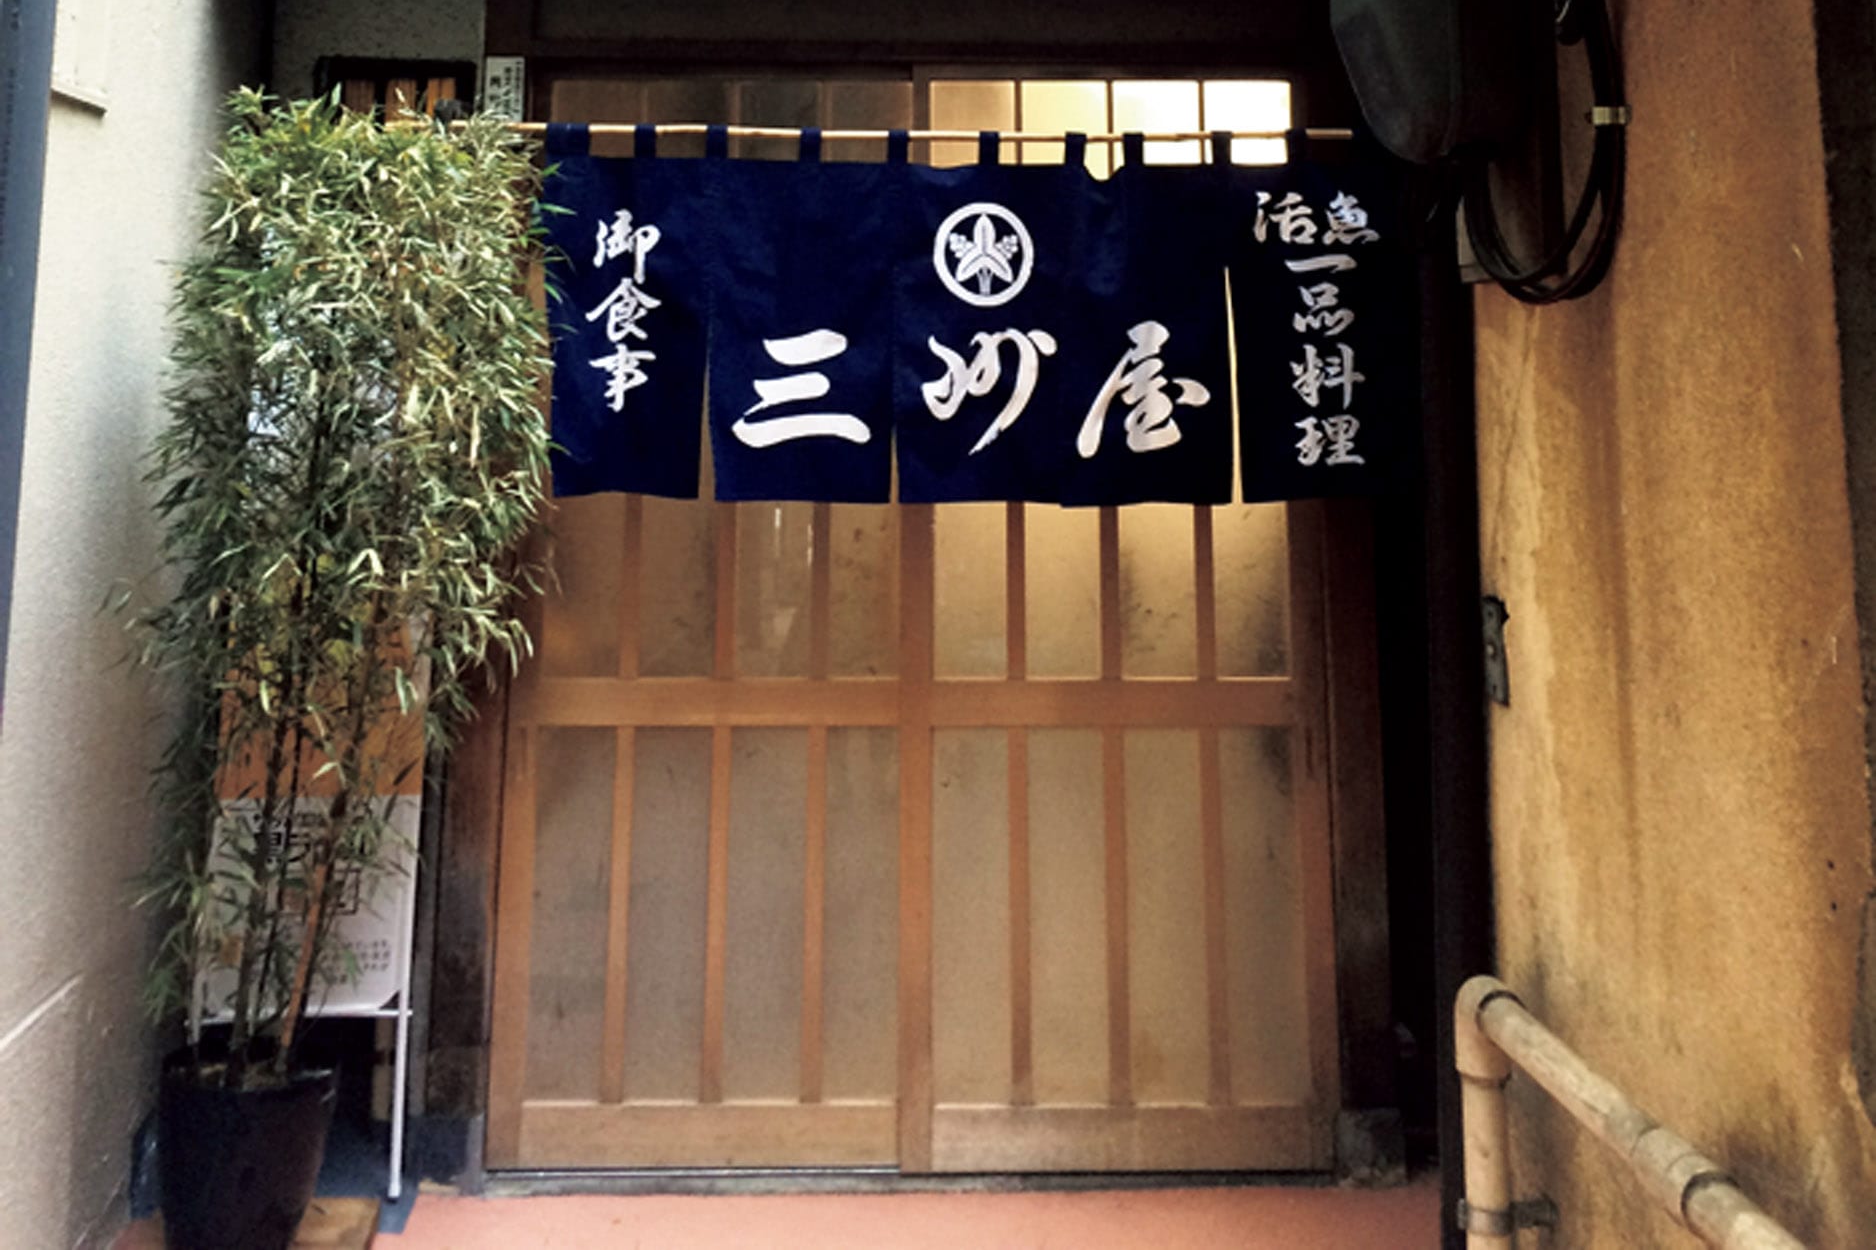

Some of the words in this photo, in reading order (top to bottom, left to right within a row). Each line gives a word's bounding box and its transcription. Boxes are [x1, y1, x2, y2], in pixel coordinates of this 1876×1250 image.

[585, 208, 662, 413] 御食事
[731, 320, 1212, 457] 三州屋
